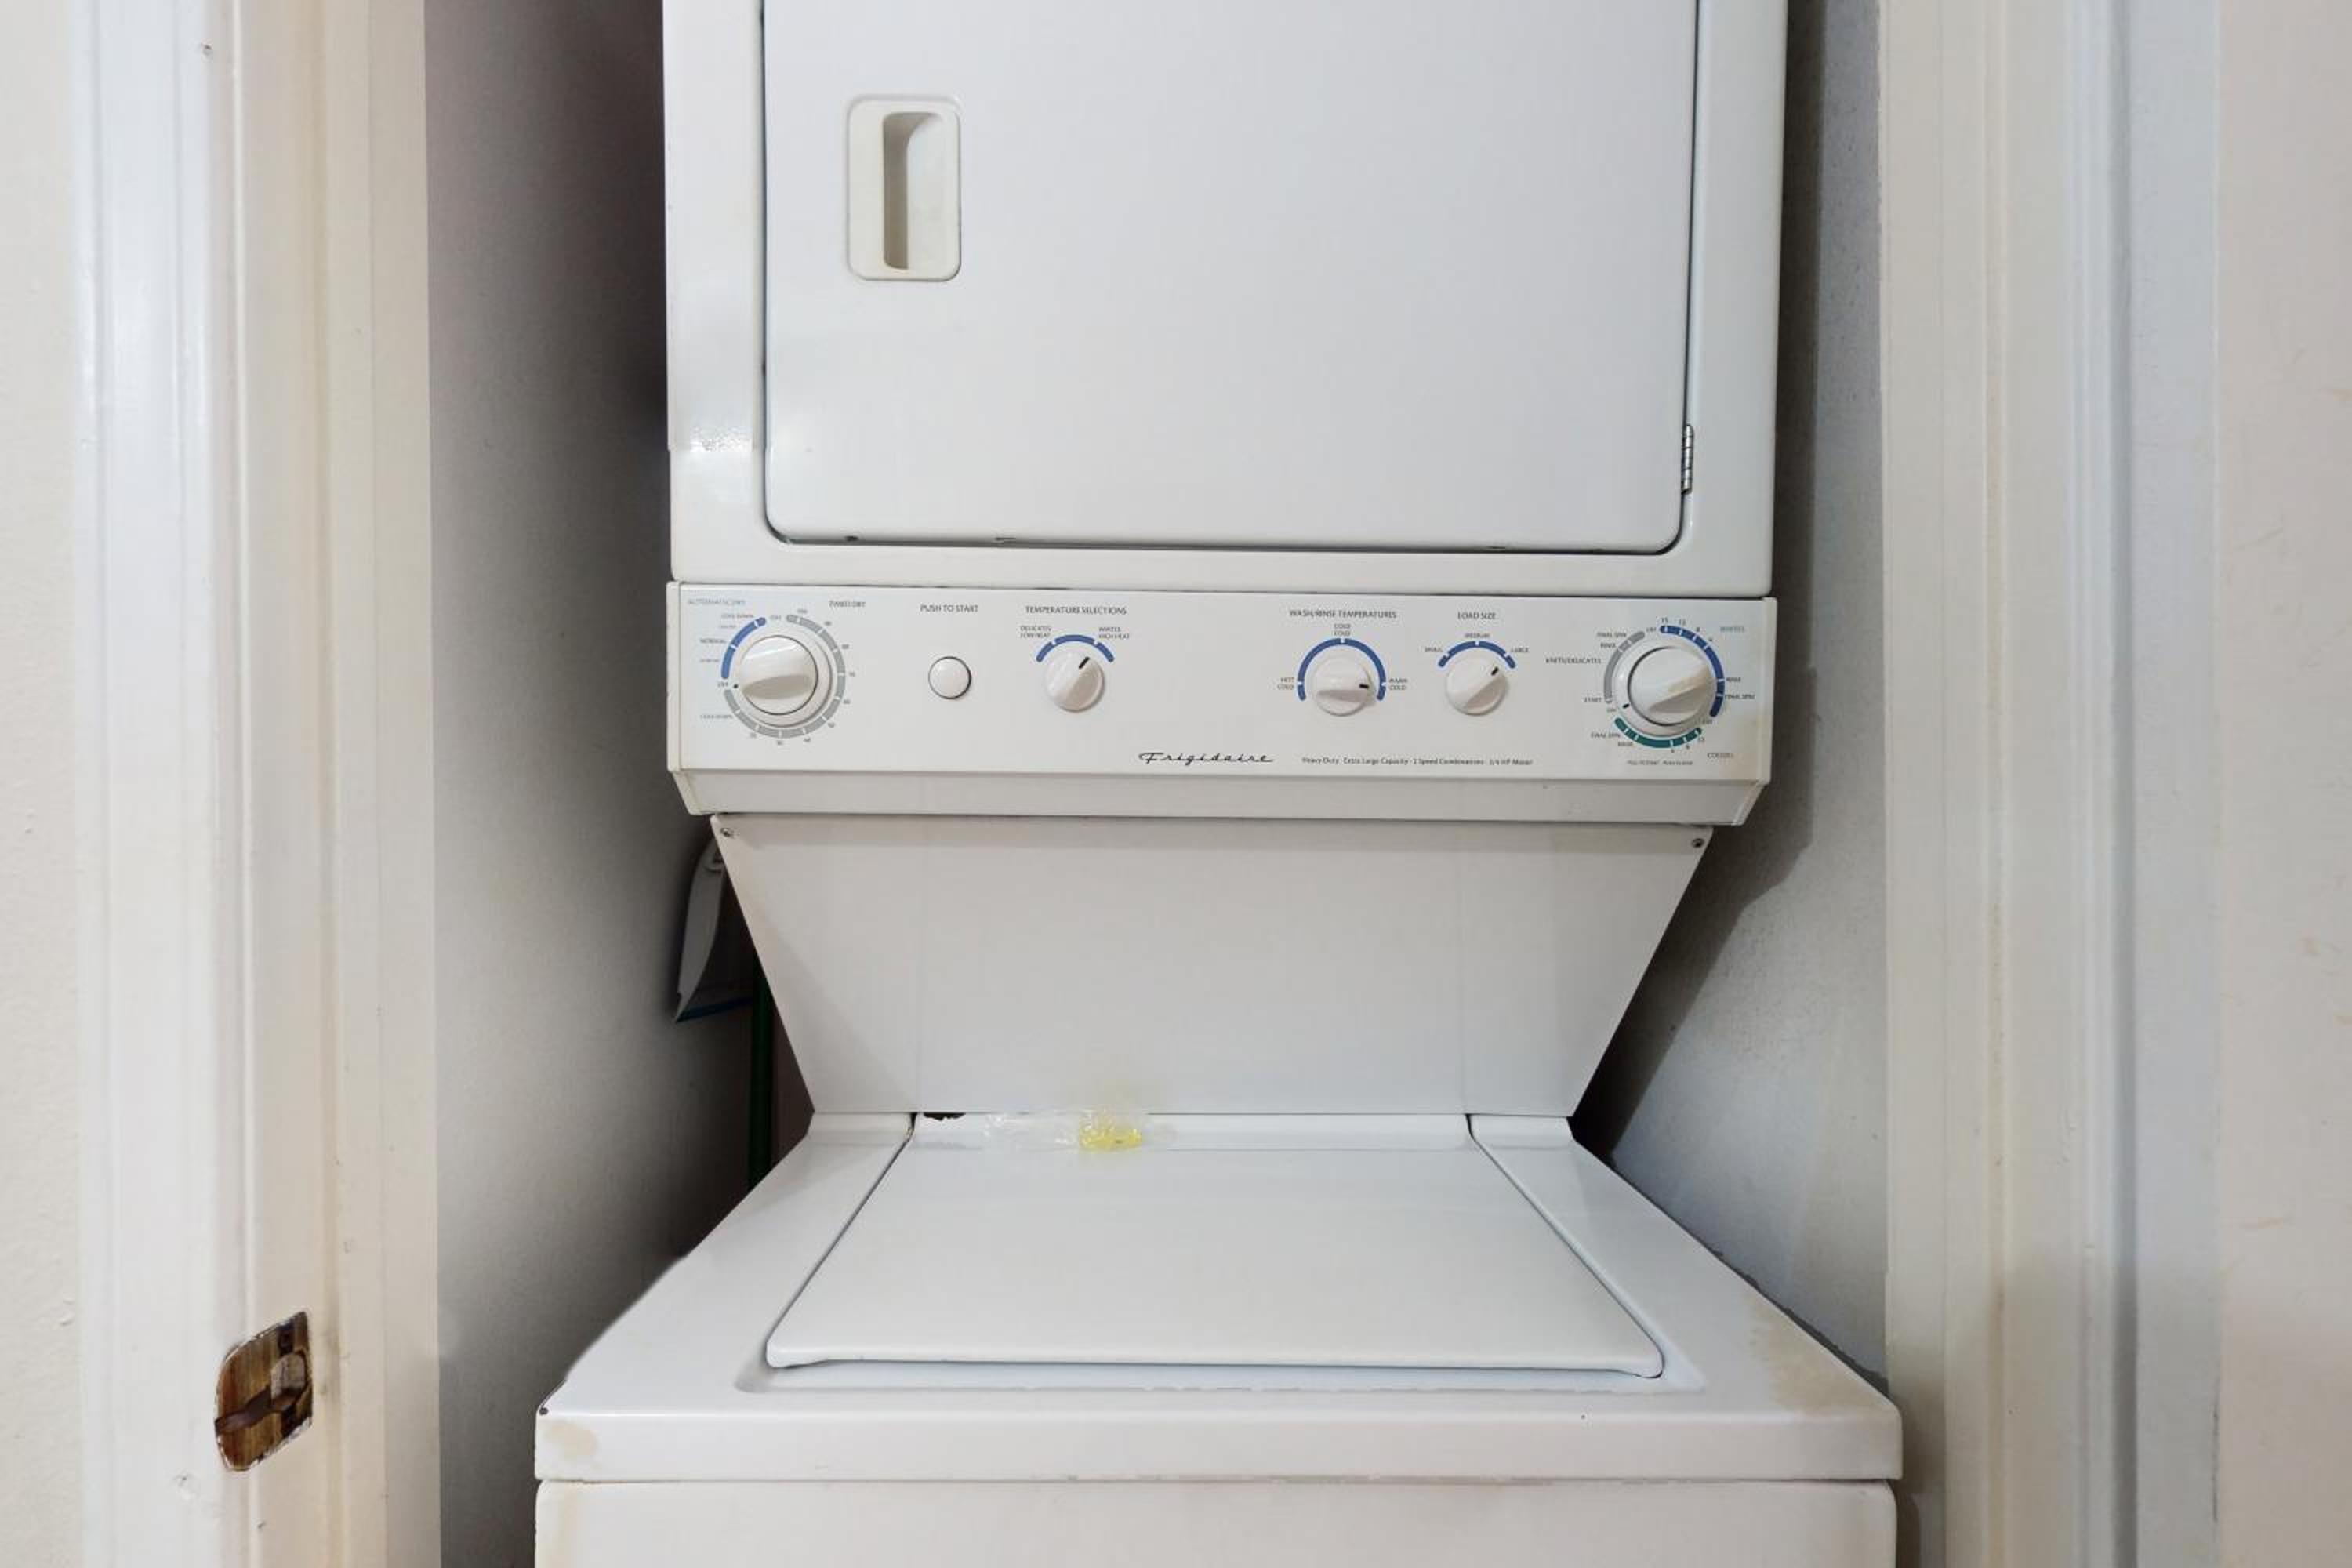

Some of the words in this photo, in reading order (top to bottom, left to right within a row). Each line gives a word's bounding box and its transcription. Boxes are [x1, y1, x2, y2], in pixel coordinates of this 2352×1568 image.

[1290, 609, 1337, 618] WASH/RINSE
[1338, 610, 1397, 619] TEMPERATURES
[1138, 752, 1274, 766] Frigidaire
